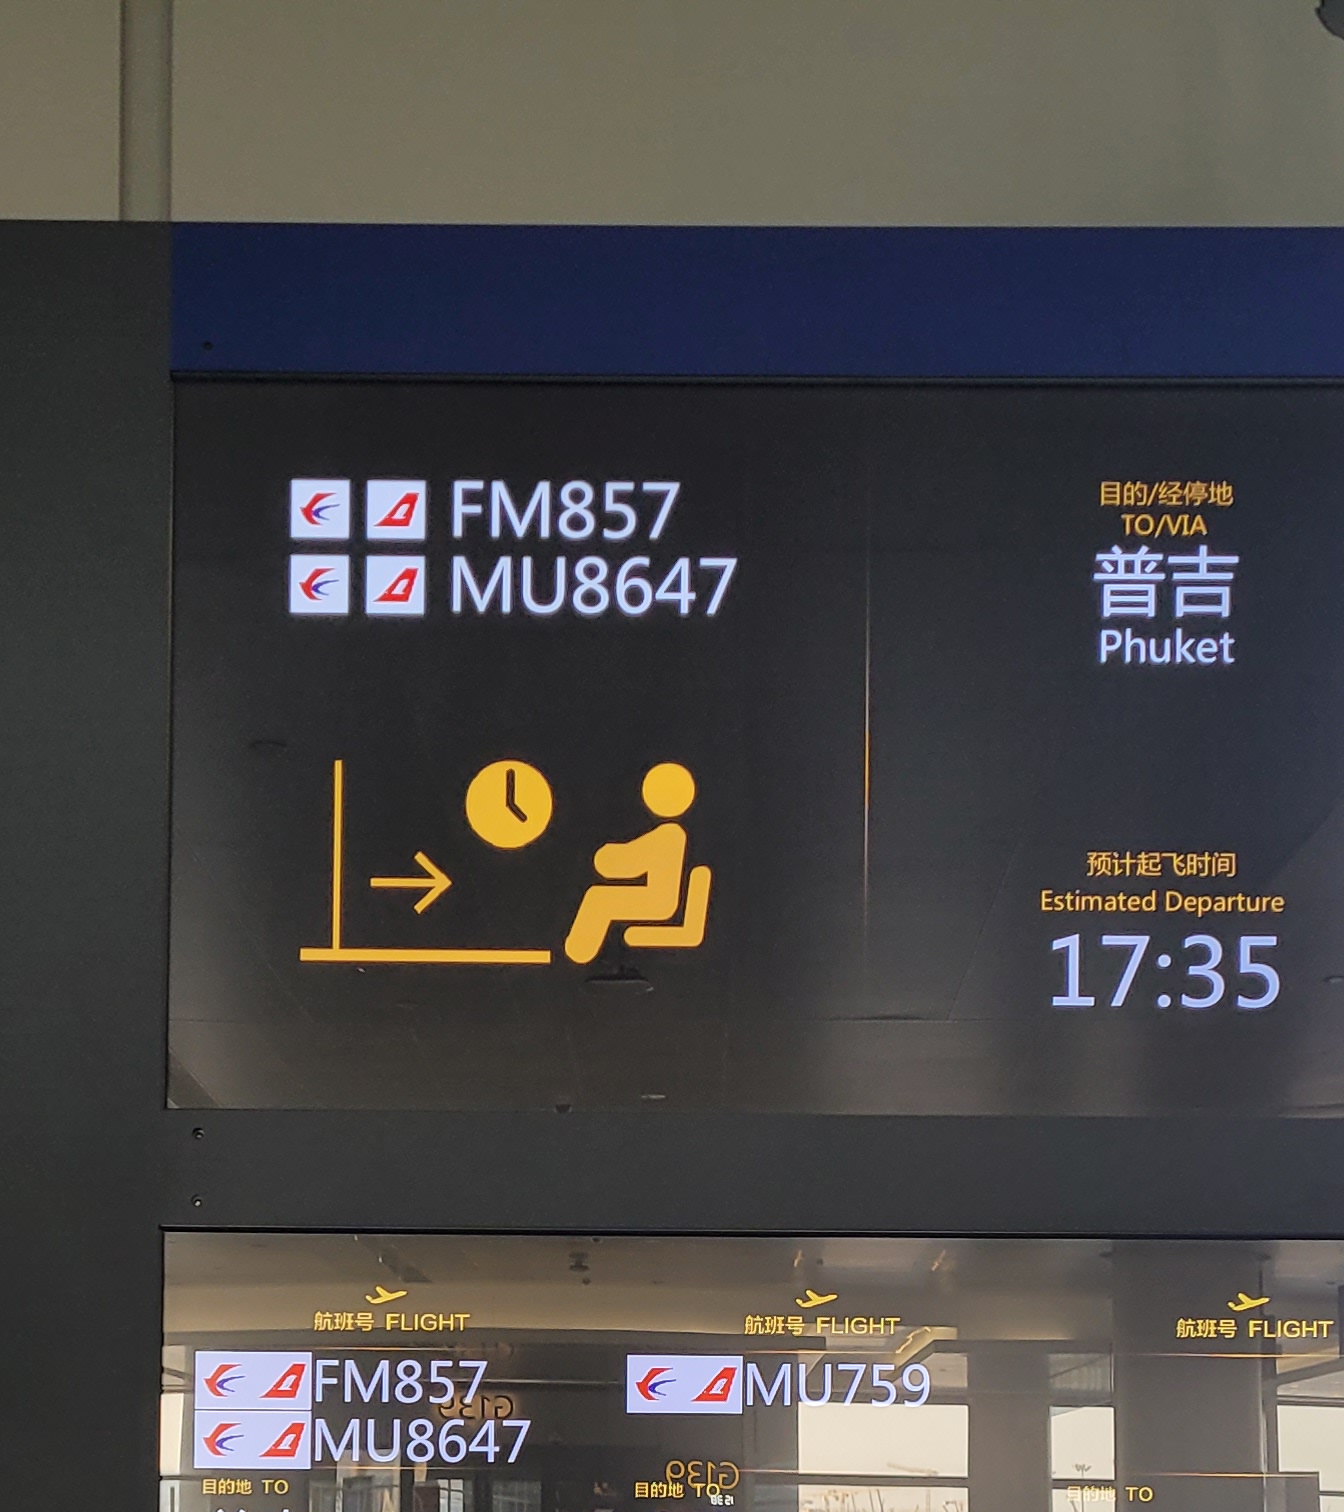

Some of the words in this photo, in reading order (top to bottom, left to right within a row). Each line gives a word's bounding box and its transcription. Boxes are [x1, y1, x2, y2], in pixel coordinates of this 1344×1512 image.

[1100, 481, 1234, 507] 目的/经停地
[452, 481, 680, 540] FM857
[1121, 514, 1208, 537] TO/VIA
[452, 556, 737, 614] MU8647
[1093, 545, 1239, 618] 普吉
[1099, 629, 1235, 663] Phuket
[1087, 851, 1237, 877] 预计起飞时间
[1040, 890, 1157, 912] Estimated
[1164, 890, 1285, 917] Departure
[1051, 933, 1281, 1009] 17:35
[314, 1311, 374, 1332] 航班号
[386, 1313, 470, 1331] FLIGHT
[744, 1315, 804, 1336] 航班号
[816, 1317, 901, 1335] FLIGHT
[1176, 1318, 1237, 1339] 航班号
[1248, 1320, 1334, 1338] FLIGHT
[315, 1360, 488, 1404] FM857
[745, 1363, 930, 1407] MU759
[315, 1419, 531, 1463] MU8647
[202, 1479, 252, 1495] 目的地
[262, 1479, 289, 1495] TO
[634, 1481, 684, 1499] 目的地
[694, 1483, 721, 1498] TO
[1066, 1486, 1115, 1503] 目的地
[1126, 1486, 1154, 1502] TO
